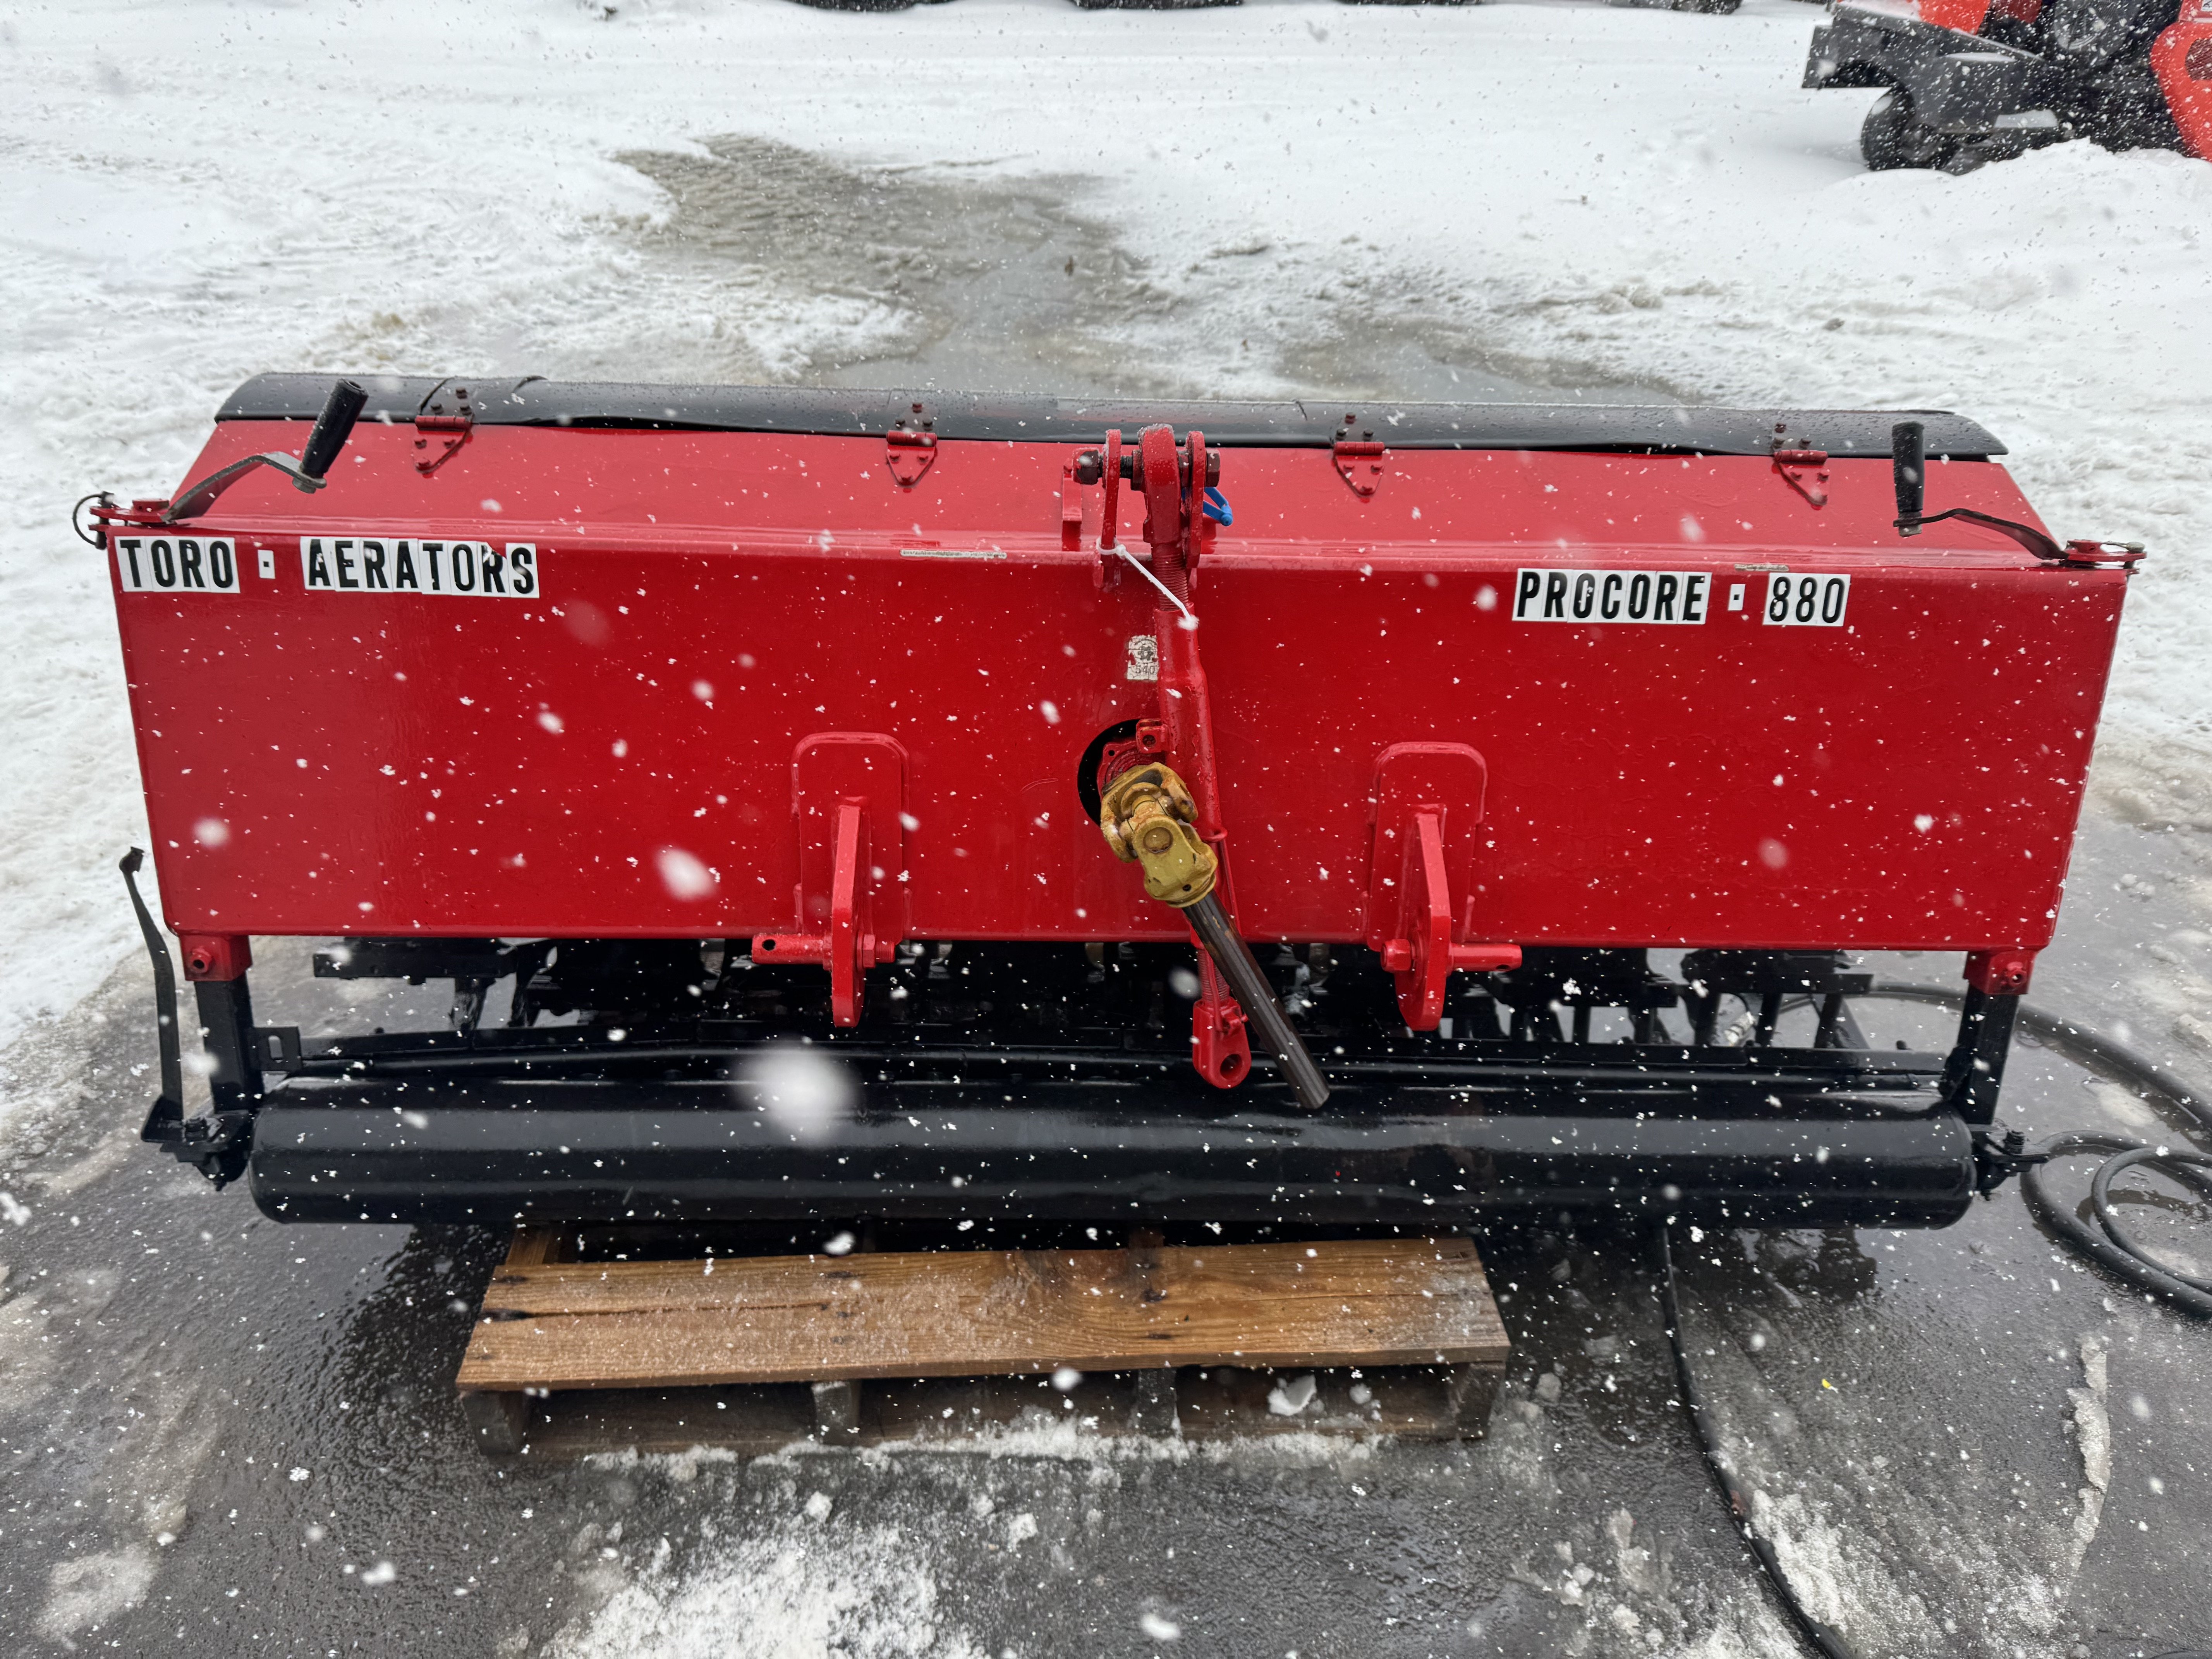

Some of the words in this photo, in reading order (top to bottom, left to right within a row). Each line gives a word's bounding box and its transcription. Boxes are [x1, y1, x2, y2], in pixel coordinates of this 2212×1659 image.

[118, 539, 234, 589] TORO
[308, 539, 535, 595] AERATORS
[1516, 571, 1705, 622] PROCORE
[1769, 576, 1844, 624] 880
[1135, 665, 1155, 674] 540
